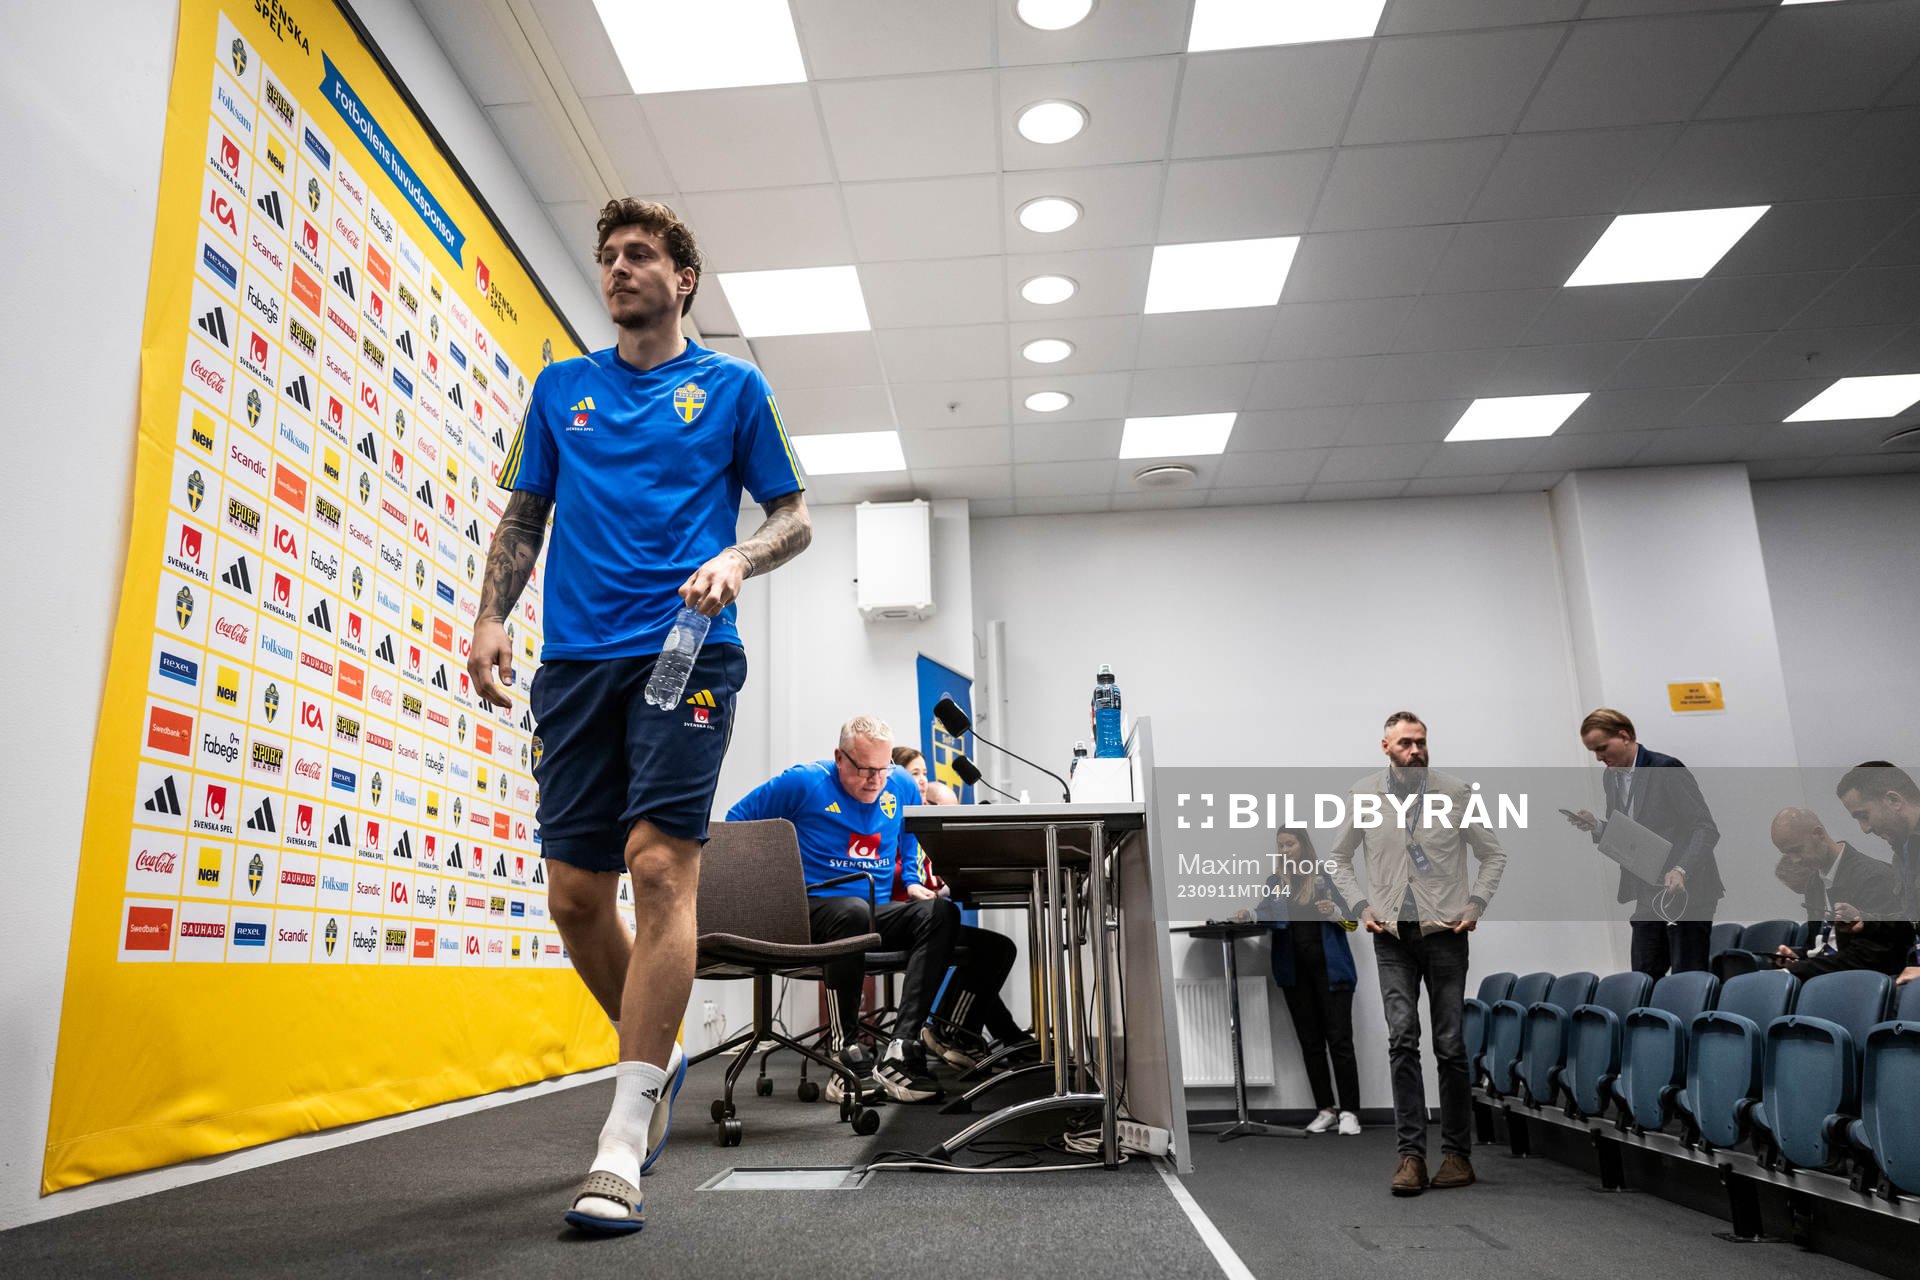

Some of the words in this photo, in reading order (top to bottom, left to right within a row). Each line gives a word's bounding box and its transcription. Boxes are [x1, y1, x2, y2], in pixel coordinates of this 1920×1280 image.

[255, 0, 284, 42] SPEL
[265, 0, 310, 56] ENSKA
[218, 86, 251, 133] Folksam
[266, 79, 295, 121] SPORT
[335, 81, 391, 163] Fotbollens
[392, 156, 455, 247] huvudsponsor
[210, 157, 233, 185] SVENSKA
[234, 181, 247, 197] SPEL
[338, 171, 364, 206] Scandic
[210, 189, 237, 236] ICA
[371, 208, 393, 244] Fabege
[252, 235, 283, 272] Scandic
[294, 242, 314, 265] SVENSKA
[314, 262, 324, 275] SPEL
[248, 285, 279, 324] Fabege
[490, 282, 518, 324] SVENSKA
[490, 298, 504, 322] SPEL
[290, 318, 316, 353] SPORT
[328, 307, 357, 342] BAUHAUS
[363, 335, 385, 365] SPORT
[475, 328, 487, 356] ICA
[240, 356, 262, 380] SVENSKA
[263, 375, 274, 388] SPEL
[326, 356, 352, 385] Scandic
[361, 382, 379, 416] ICA
[280, 423, 309, 454] Folksam
[320, 419, 338, 439] SVENSKA
[339, 435, 348, 445] SPEL
[231, 445, 267, 478] Scandic
[491, 461, 501, 481] IC
[229, 498, 260, 530] SPORT
[316, 496, 341, 527] SPORT
[229, 517, 258, 537] BLADET
[349, 524, 373, 548] Scandic
[414, 519, 429, 547] ICA
[274, 524, 298, 559] ICA
[167, 556, 195, 574] SVENSKA
[195, 570, 209, 581] SPEL
[311, 550, 338, 580] Fabege
[381, 544, 402, 571] Fabege
[263, 601, 285, 618] SVENSKA
[286, 612, 297, 622] SPEL
[261, 635, 293, 661] Folksam
[340, 638, 357, 653] SVENSKA
[357, 647, 366, 656] SPEL
[459, 635, 471, 657] IC
[301, 652, 333, 676] BAUHAUS
[302, 701, 324, 731] ICA
[402, 693, 422, 714] SPORT
[152, 723, 180, 738] Swedbank
[337, 715, 360, 738] SPORT
[203, 733, 239, 763] Fabege
[367, 732, 392, 751] BAUHAUS
[398, 744, 418, 761] Scandic
[253, 743, 283, 767] SPORT
[253, 761, 281, 774] BLADET
[425, 752, 444, 775] Fabege
[194, 820, 219, 832] SVENSKA
[220, 824, 233, 834] SPEL
[515, 822, 526, 841] ICA
[286, 836, 306, 846] SVENSKA
[307, 840, 317, 848] SPEL
[359, 850, 375, 859] SVENSKA
[376, 852, 384, 860] SPEL
[281, 871, 316, 887] BAUHAUS
[322, 875, 348, 891] Folksam
[357, 882, 380, 896] Scandic
[391, 882, 408, 904] ICA
[417, 888, 436, 909] Fabege
[491, 897, 505, 911] SPORT
[130, 923, 159, 933] Swedbank
[181, 922, 225, 938] BAUHAUS
[278, 928, 308, 943] Scandic
[385, 929, 406, 945] SPORT
[353, 931, 376, 952] Fabege
[466, 936, 480, 955] ICA
